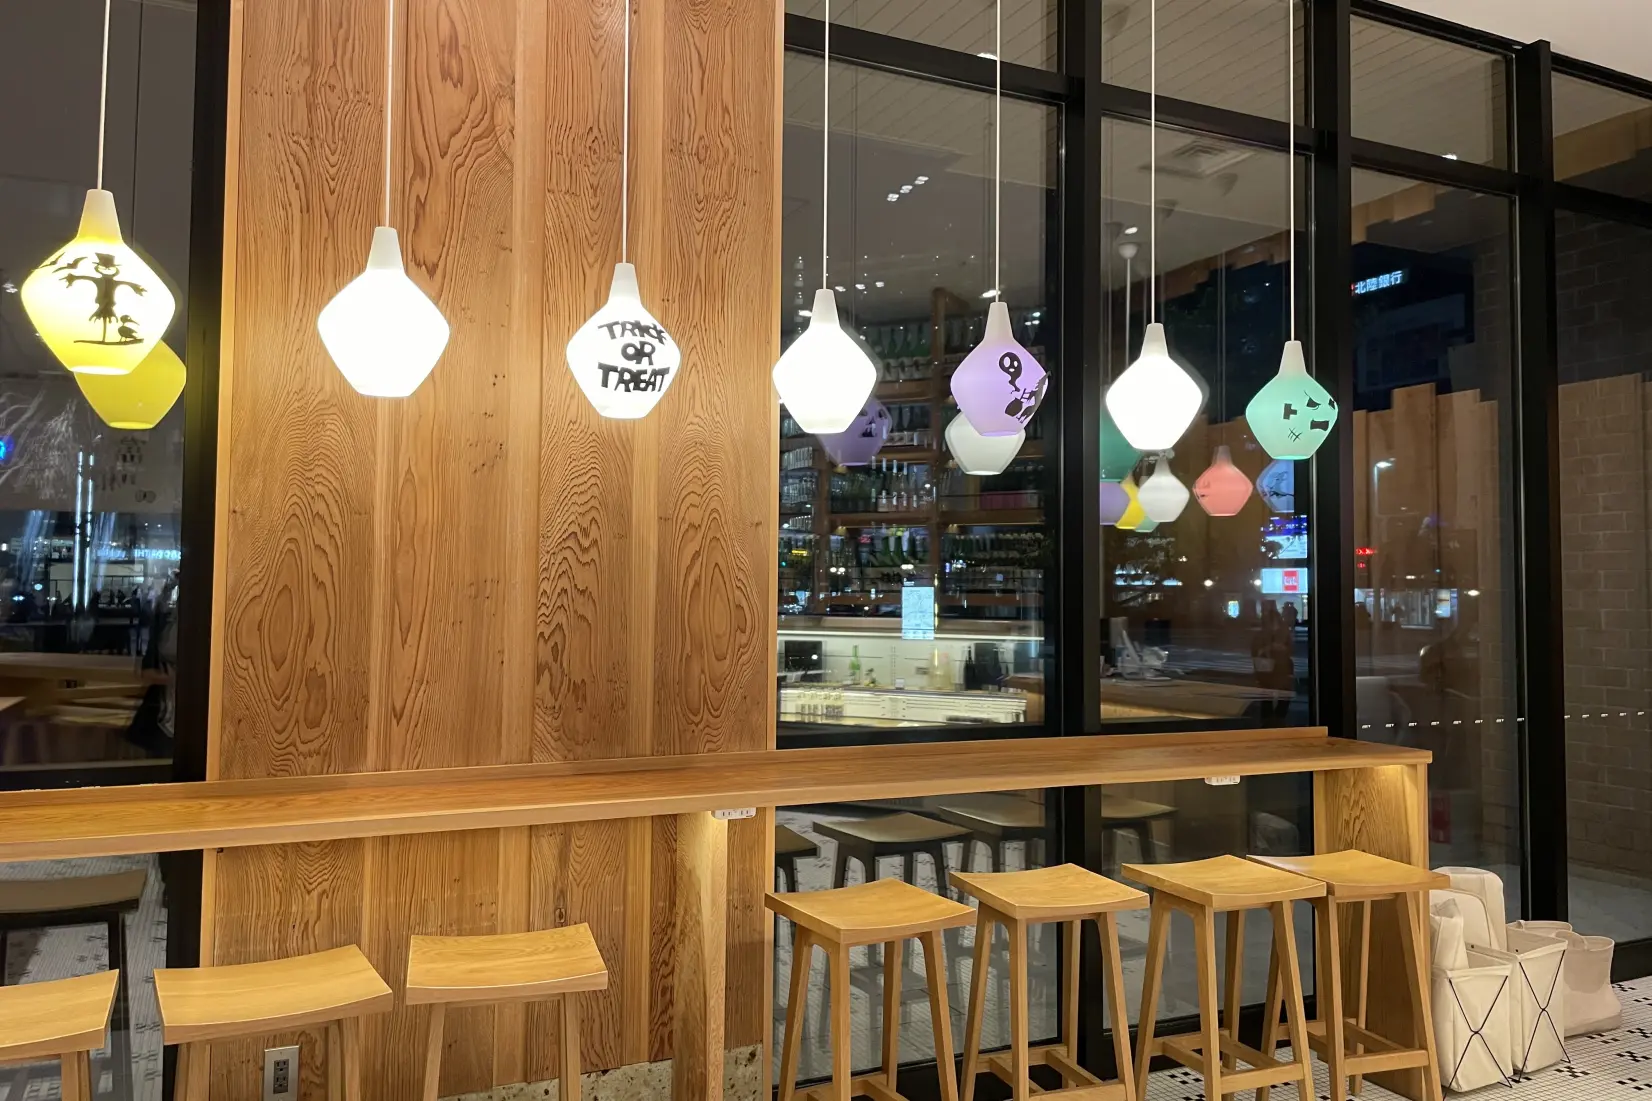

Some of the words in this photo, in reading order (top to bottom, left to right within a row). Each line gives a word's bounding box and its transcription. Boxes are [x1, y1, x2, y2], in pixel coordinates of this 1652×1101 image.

[1355, 270, 1402, 294] 北陸銀行
[598, 320, 667, 346] TRICK
[621, 341, 656, 365] OR
[598, 361, 670, 393] TREAT
